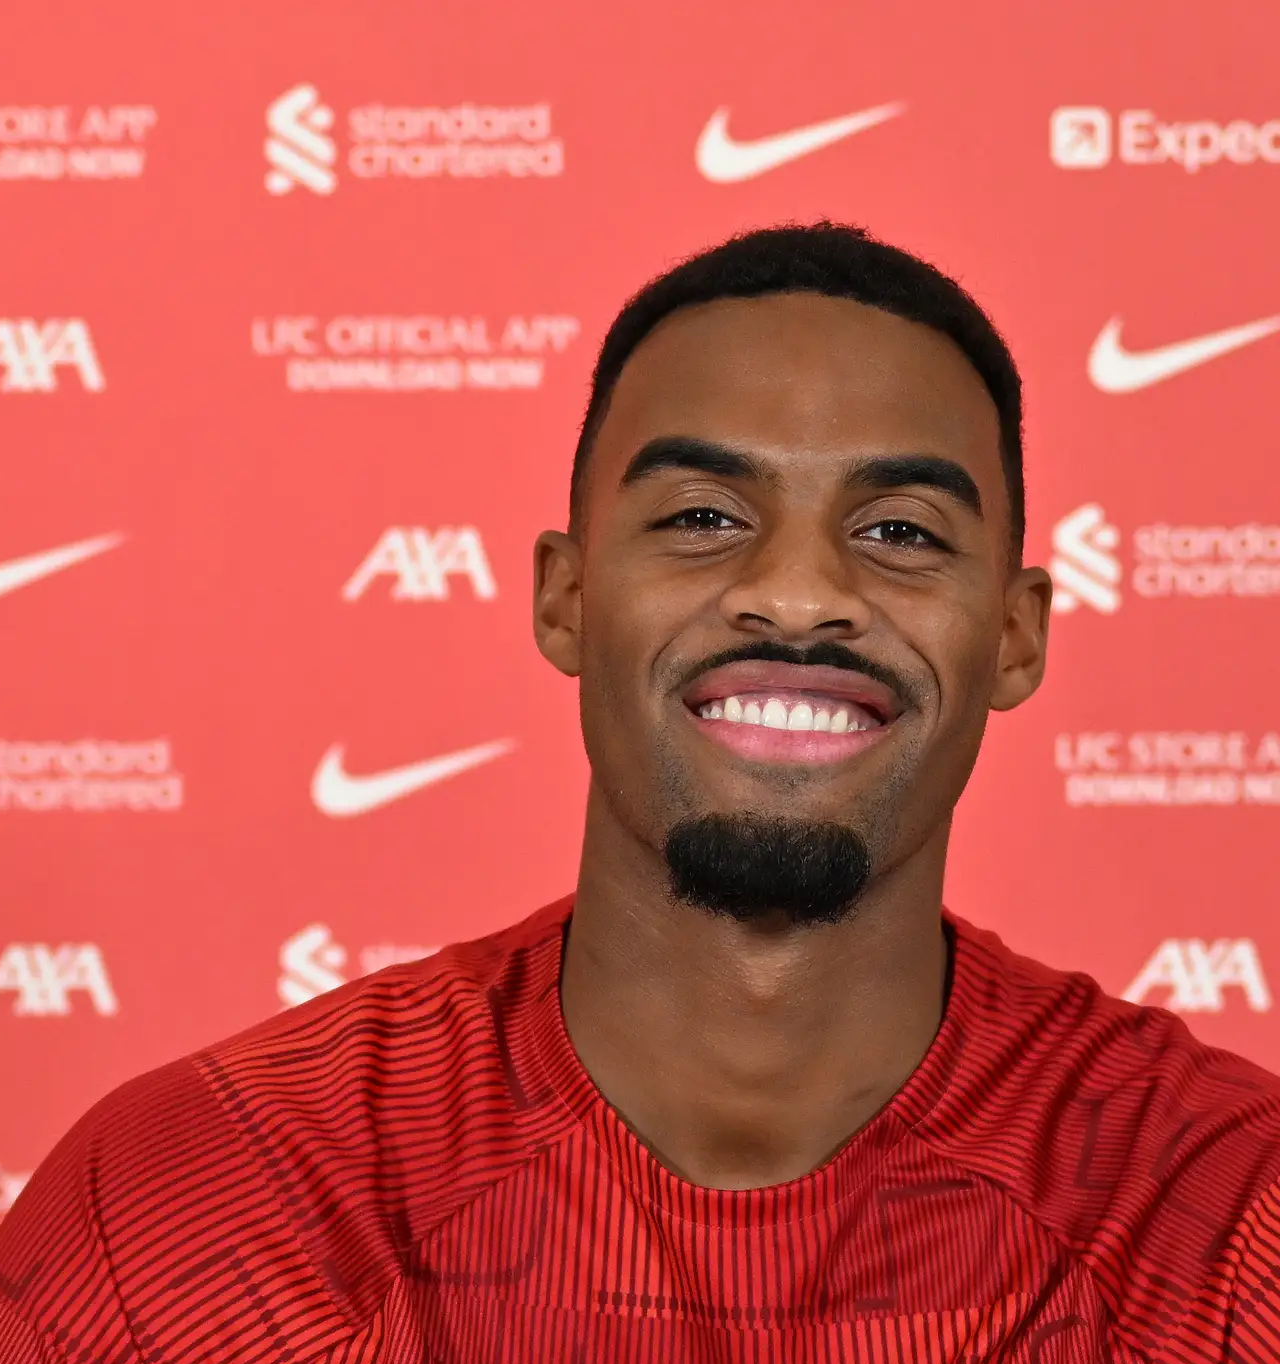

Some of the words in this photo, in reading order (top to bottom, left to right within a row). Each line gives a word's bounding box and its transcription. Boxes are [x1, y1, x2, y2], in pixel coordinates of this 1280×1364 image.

[80, 106, 157, 141] APP
[348, 103, 552, 142] standard
[348, 139, 564, 178] chartered
[252, 316, 318, 355] LFC
[326, 316, 492, 355] OFFICIAL
[502, 316, 580, 351] APP
[344, 527, 497, 600] AXA
[1055, 733, 1119, 770] LFC
[1129, 733, 1246, 770] STORE
[1121, 938, 1273, 1014] AXA
